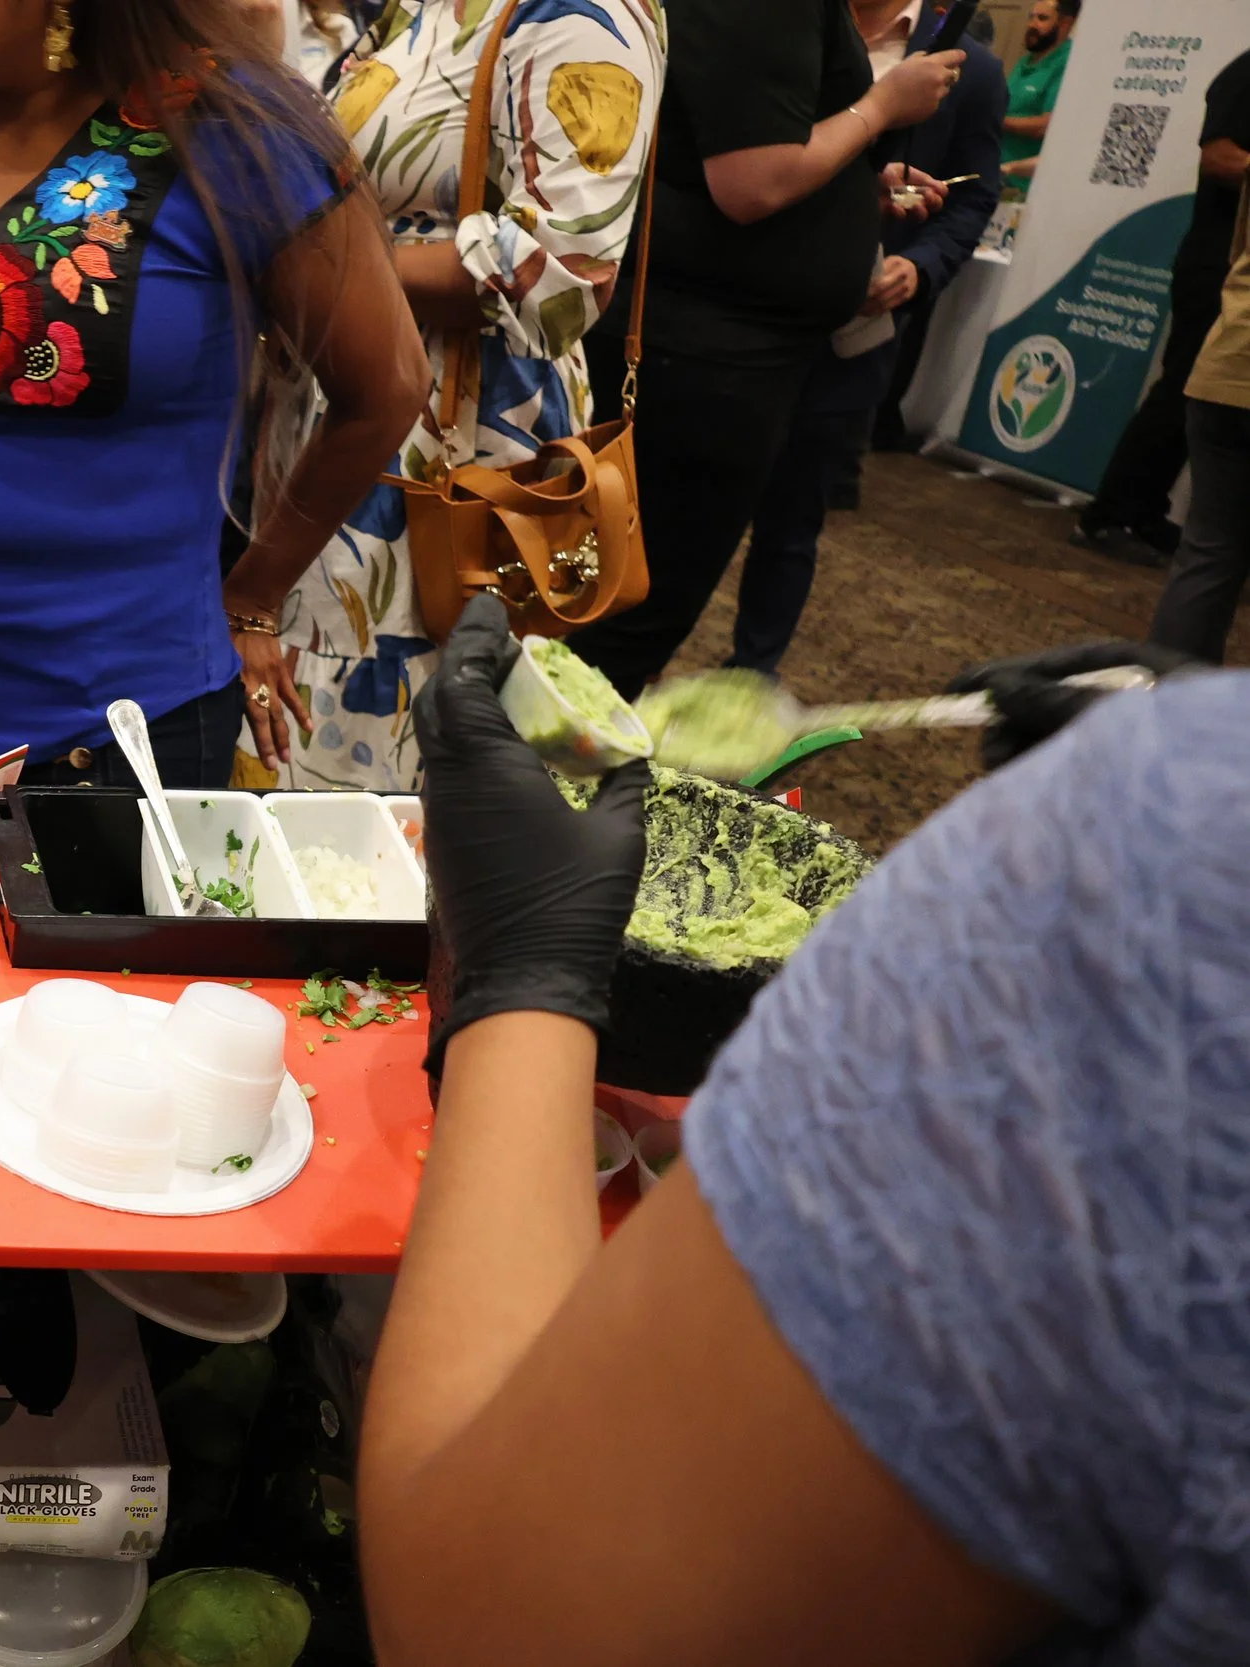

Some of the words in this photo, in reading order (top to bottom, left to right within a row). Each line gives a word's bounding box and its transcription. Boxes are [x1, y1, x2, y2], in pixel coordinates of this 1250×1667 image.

[132, 1474, 155, 1482] Exam
[130, 1485, 156, 1493] Grade
[42, 1506, 96, 1517] GLOVES
